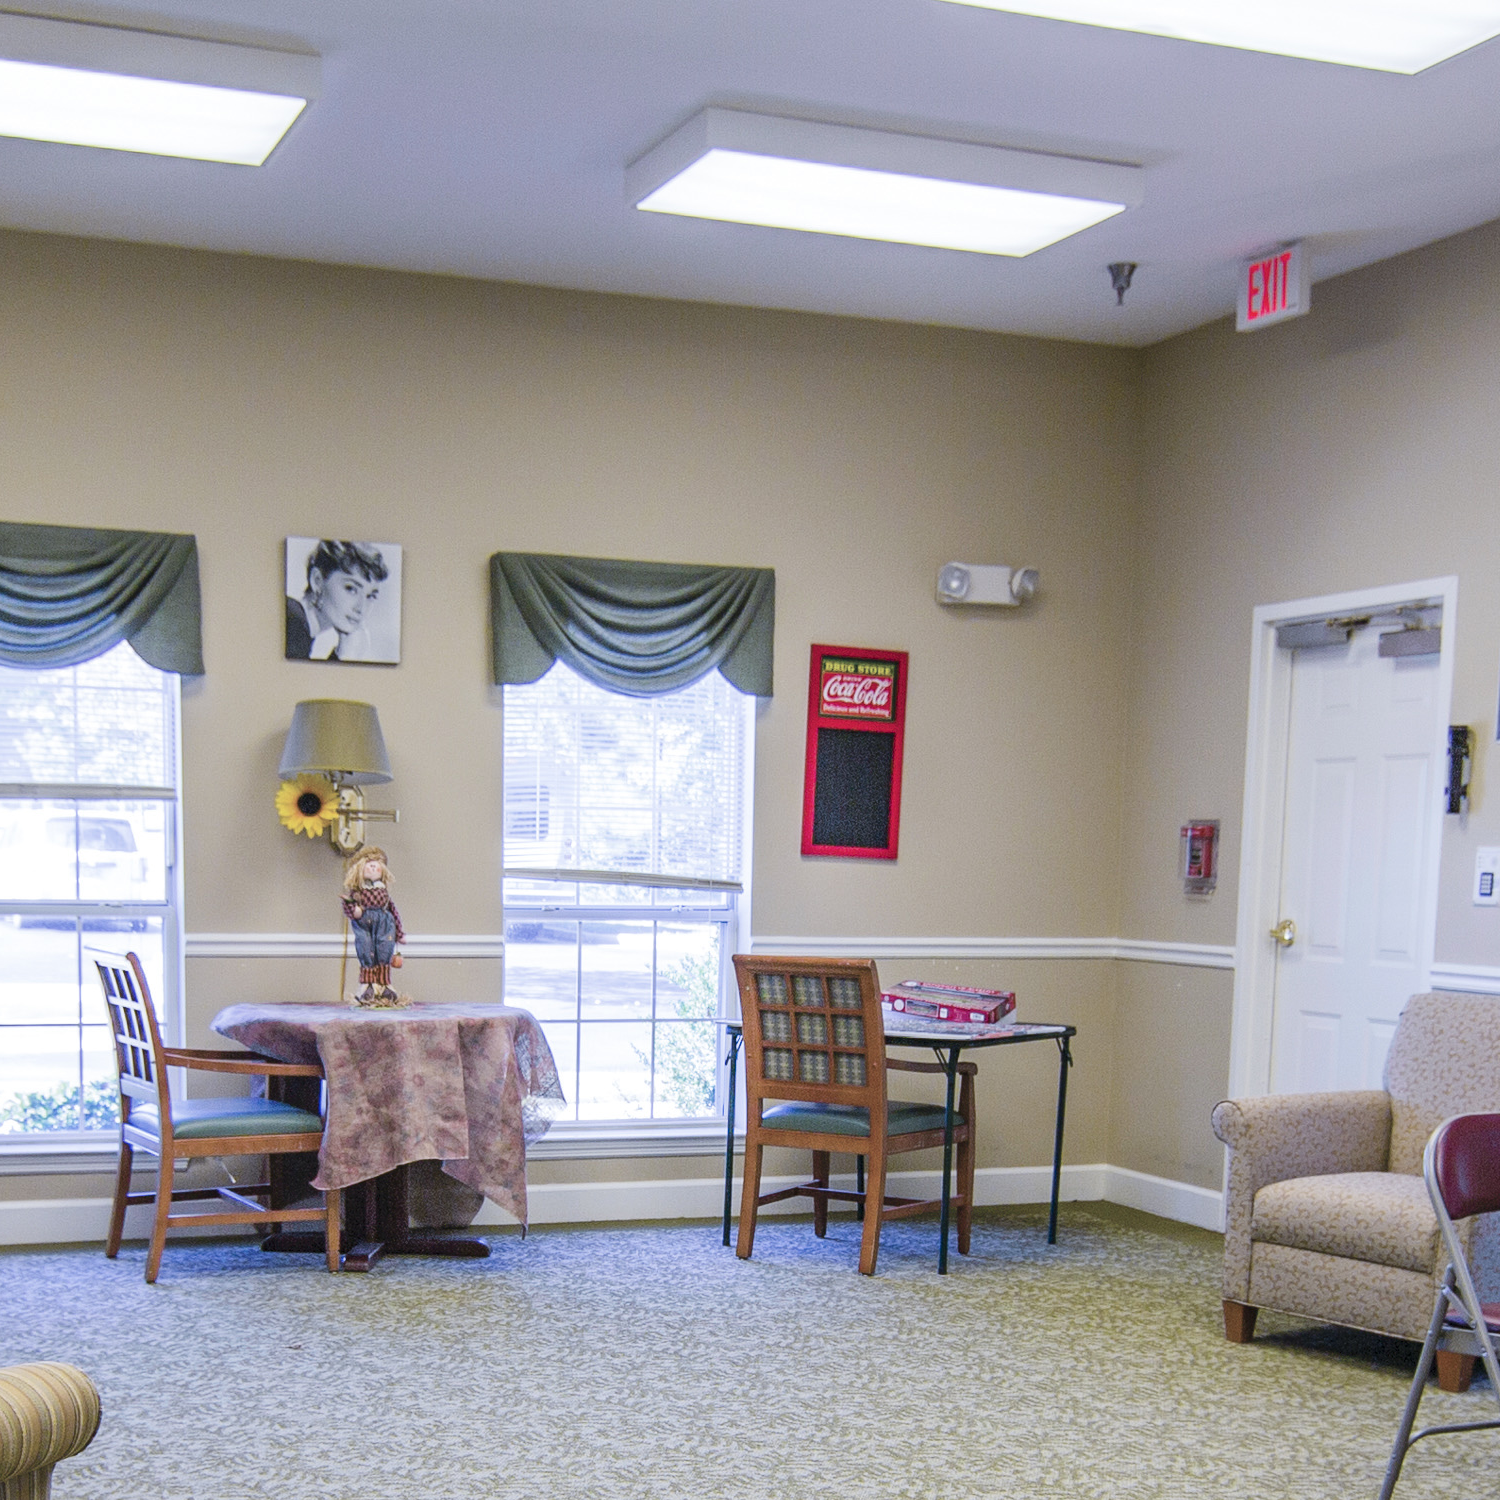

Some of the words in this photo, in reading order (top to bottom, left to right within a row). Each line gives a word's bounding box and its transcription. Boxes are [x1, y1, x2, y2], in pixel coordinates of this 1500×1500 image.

[1247, 252, 1291, 320] EXIT
[825, 662, 855, 672] DRUG
[857, 665, 891, 675] STORE
